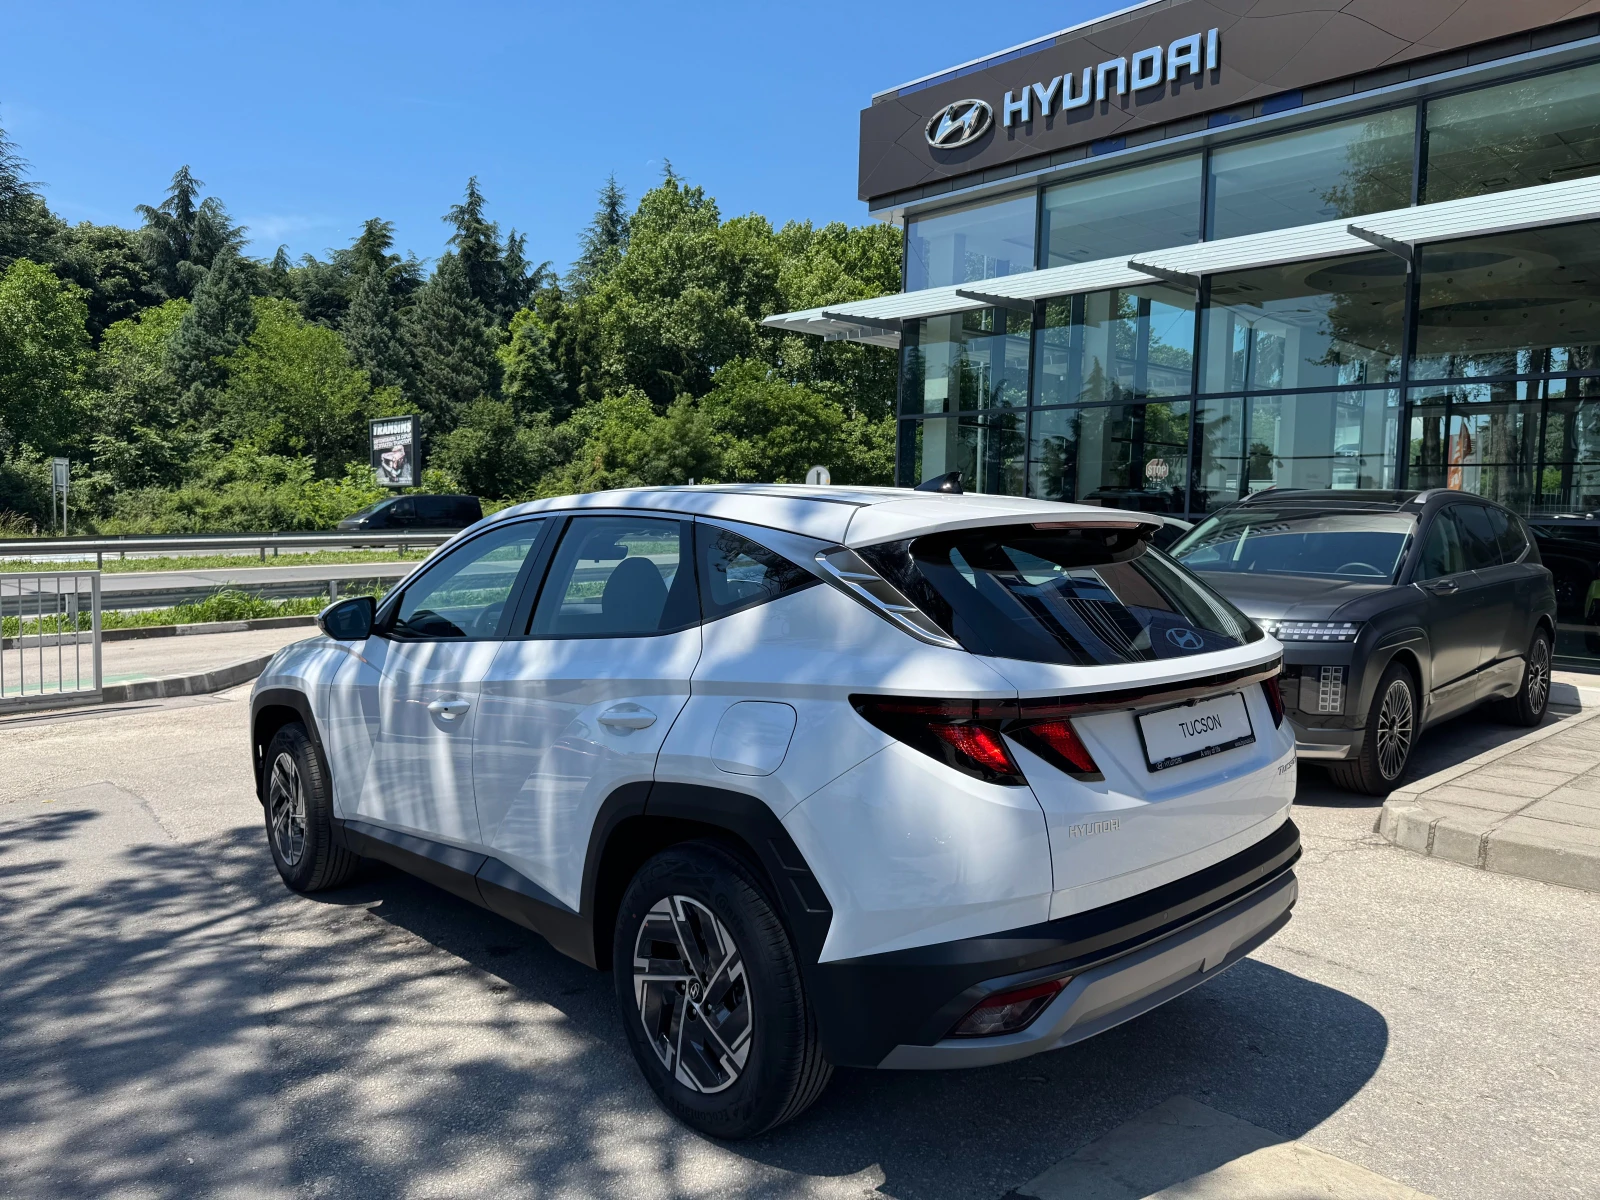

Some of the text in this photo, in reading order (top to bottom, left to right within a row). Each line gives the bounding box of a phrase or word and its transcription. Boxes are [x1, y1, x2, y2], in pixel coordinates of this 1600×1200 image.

[1003, 27, 1219, 128] HYUNDAI
[373, 420, 412, 435] TRANSINS
[1147, 465, 1167, 475] STOP
[1179, 713, 1222, 738] TUCSON
[1068, 818, 1120, 838] HYUNDAI
